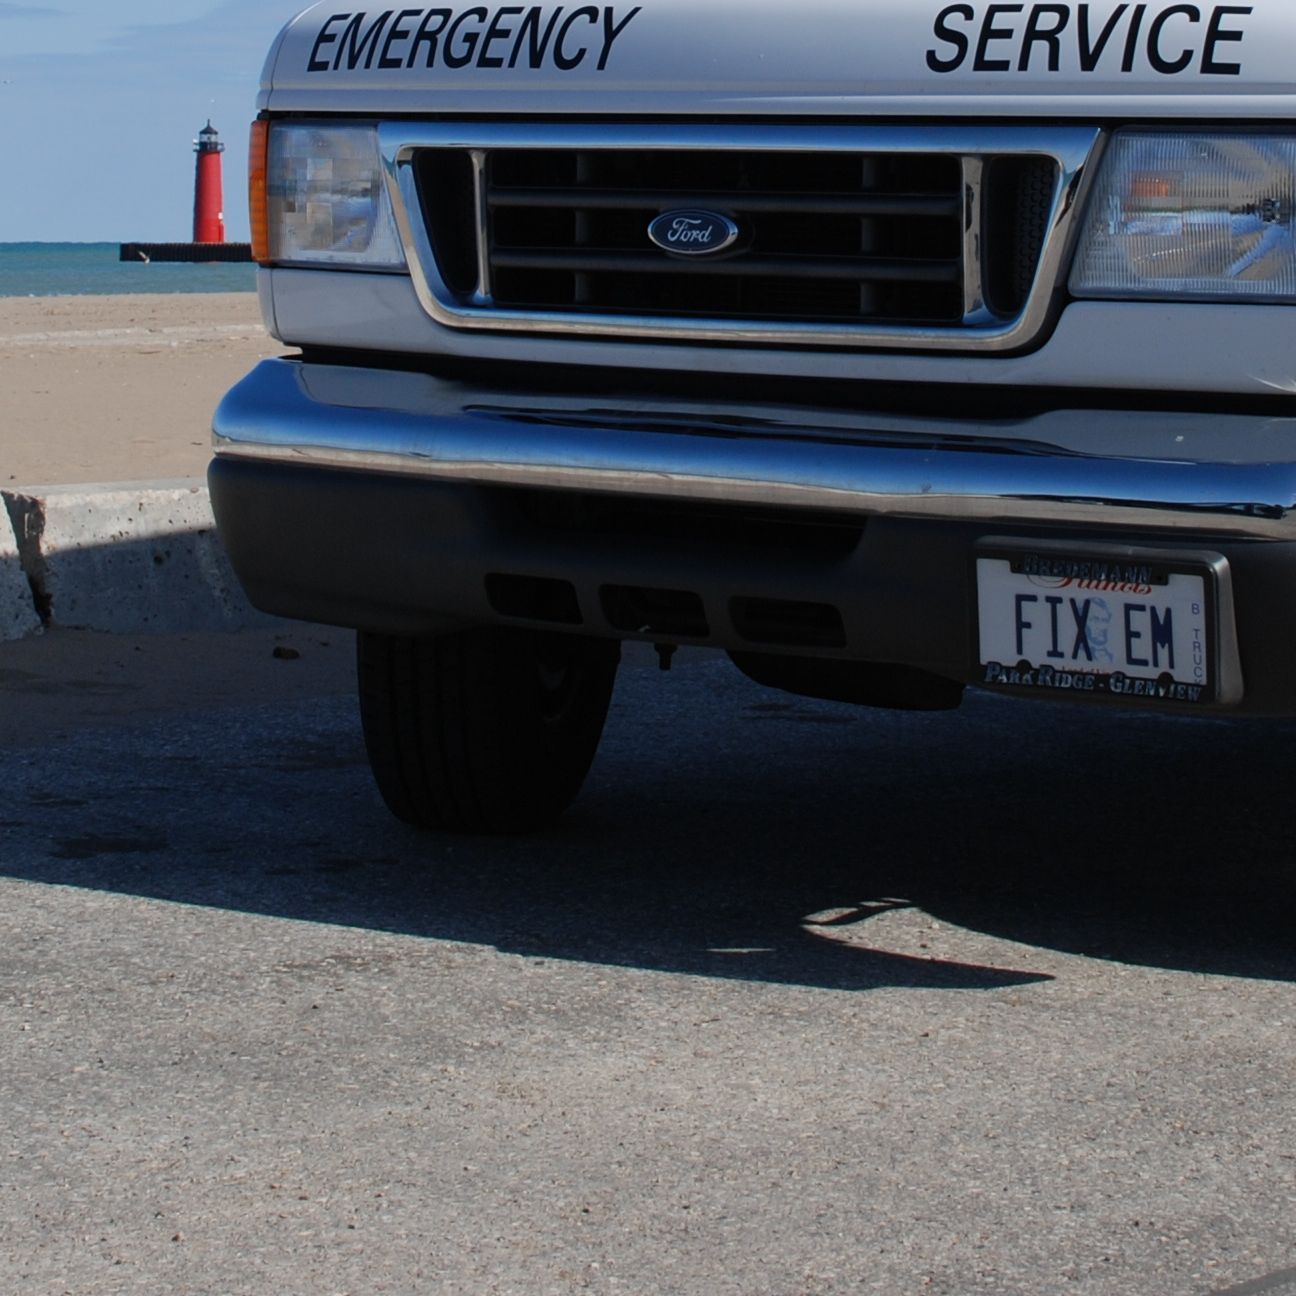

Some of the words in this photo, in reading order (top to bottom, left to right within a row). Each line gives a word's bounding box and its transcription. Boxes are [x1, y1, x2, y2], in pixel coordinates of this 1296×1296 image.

[307, 6, 642, 72] EMERGENCY
[925, 3, 1254, 76] SERVICE
[667, 218, 713, 242] Ford
[1191, 603, 1201, 615] B
[1015, 594, 1093, 662] FIX
[1123, 603, 1175, 670] EM
[984, 662, 1034, 687] PARK
[1036, 665, 1094, 692] RIDGE
[1109, 671, 1202, 702] GLENVIEW
